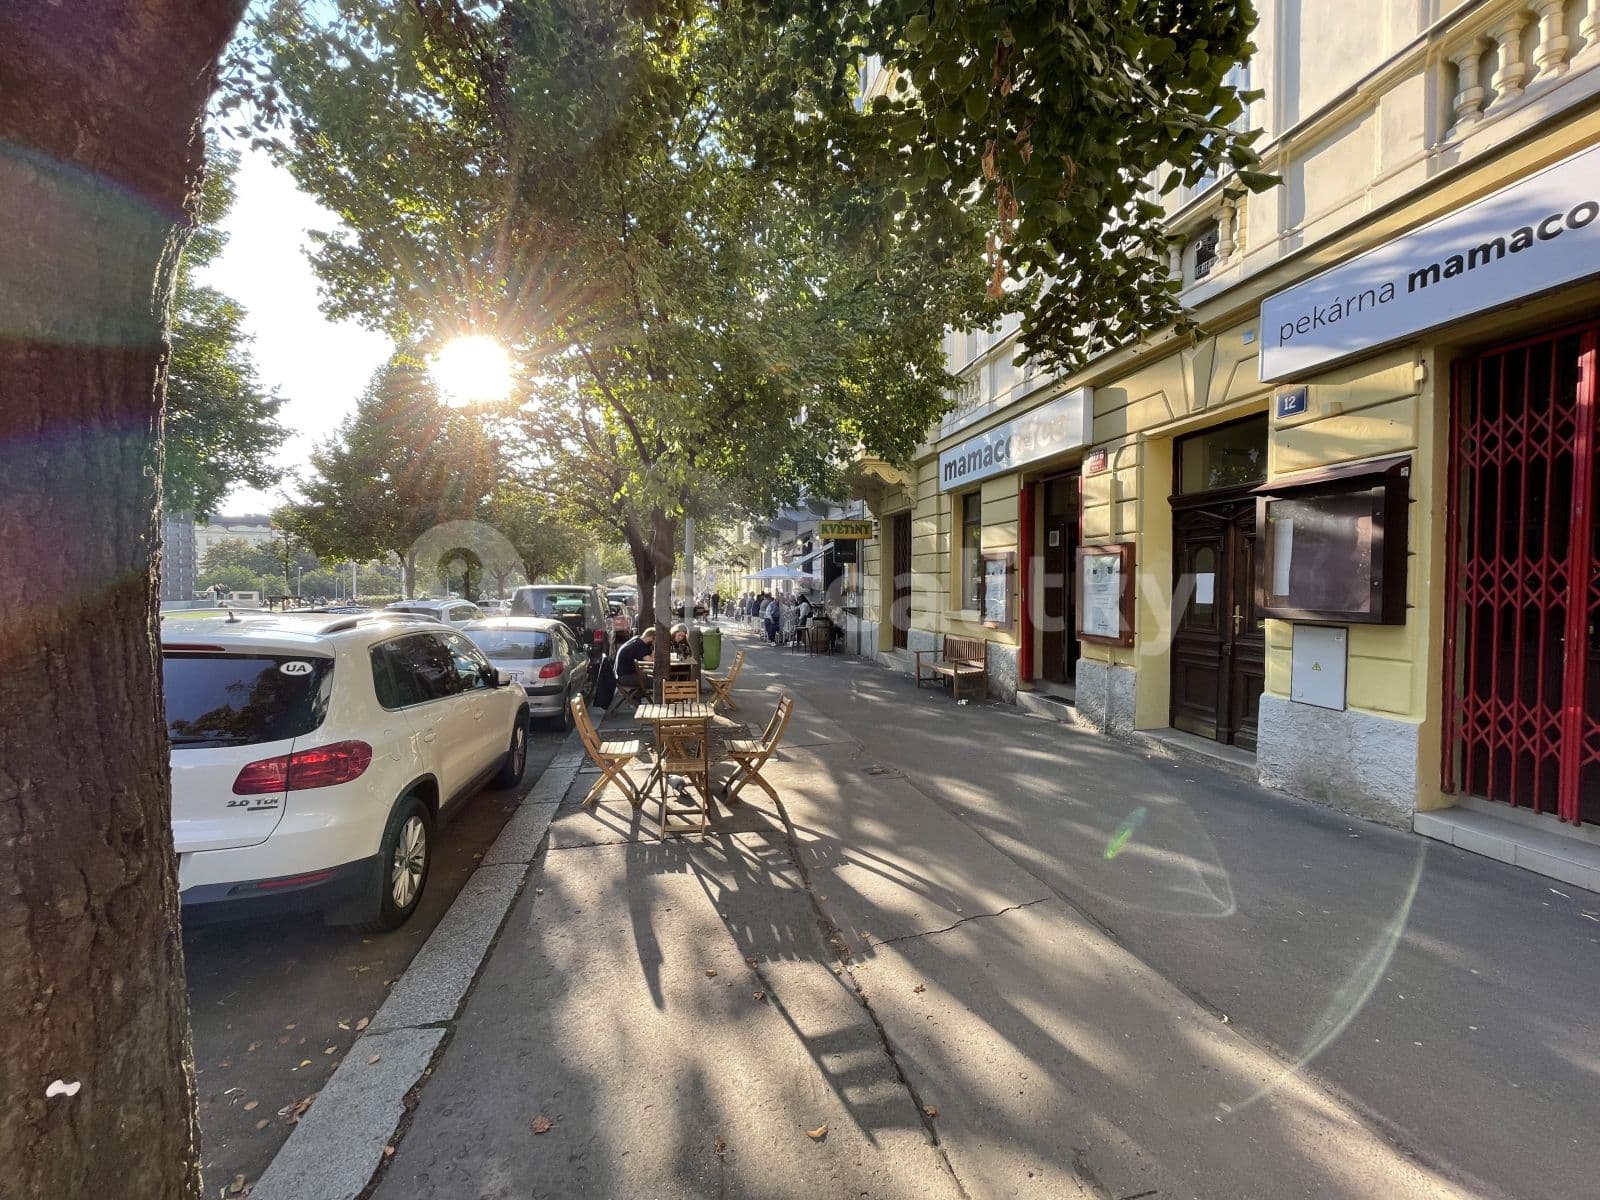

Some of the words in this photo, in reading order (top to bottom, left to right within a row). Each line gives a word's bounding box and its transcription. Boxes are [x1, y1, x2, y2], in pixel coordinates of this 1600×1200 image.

[1279, 282, 1395, 347] pekárna
[1407, 201, 1600, 292] mamaco
[1284, 395, 1297, 411] 12
[286, 663, 307, 673] UA
